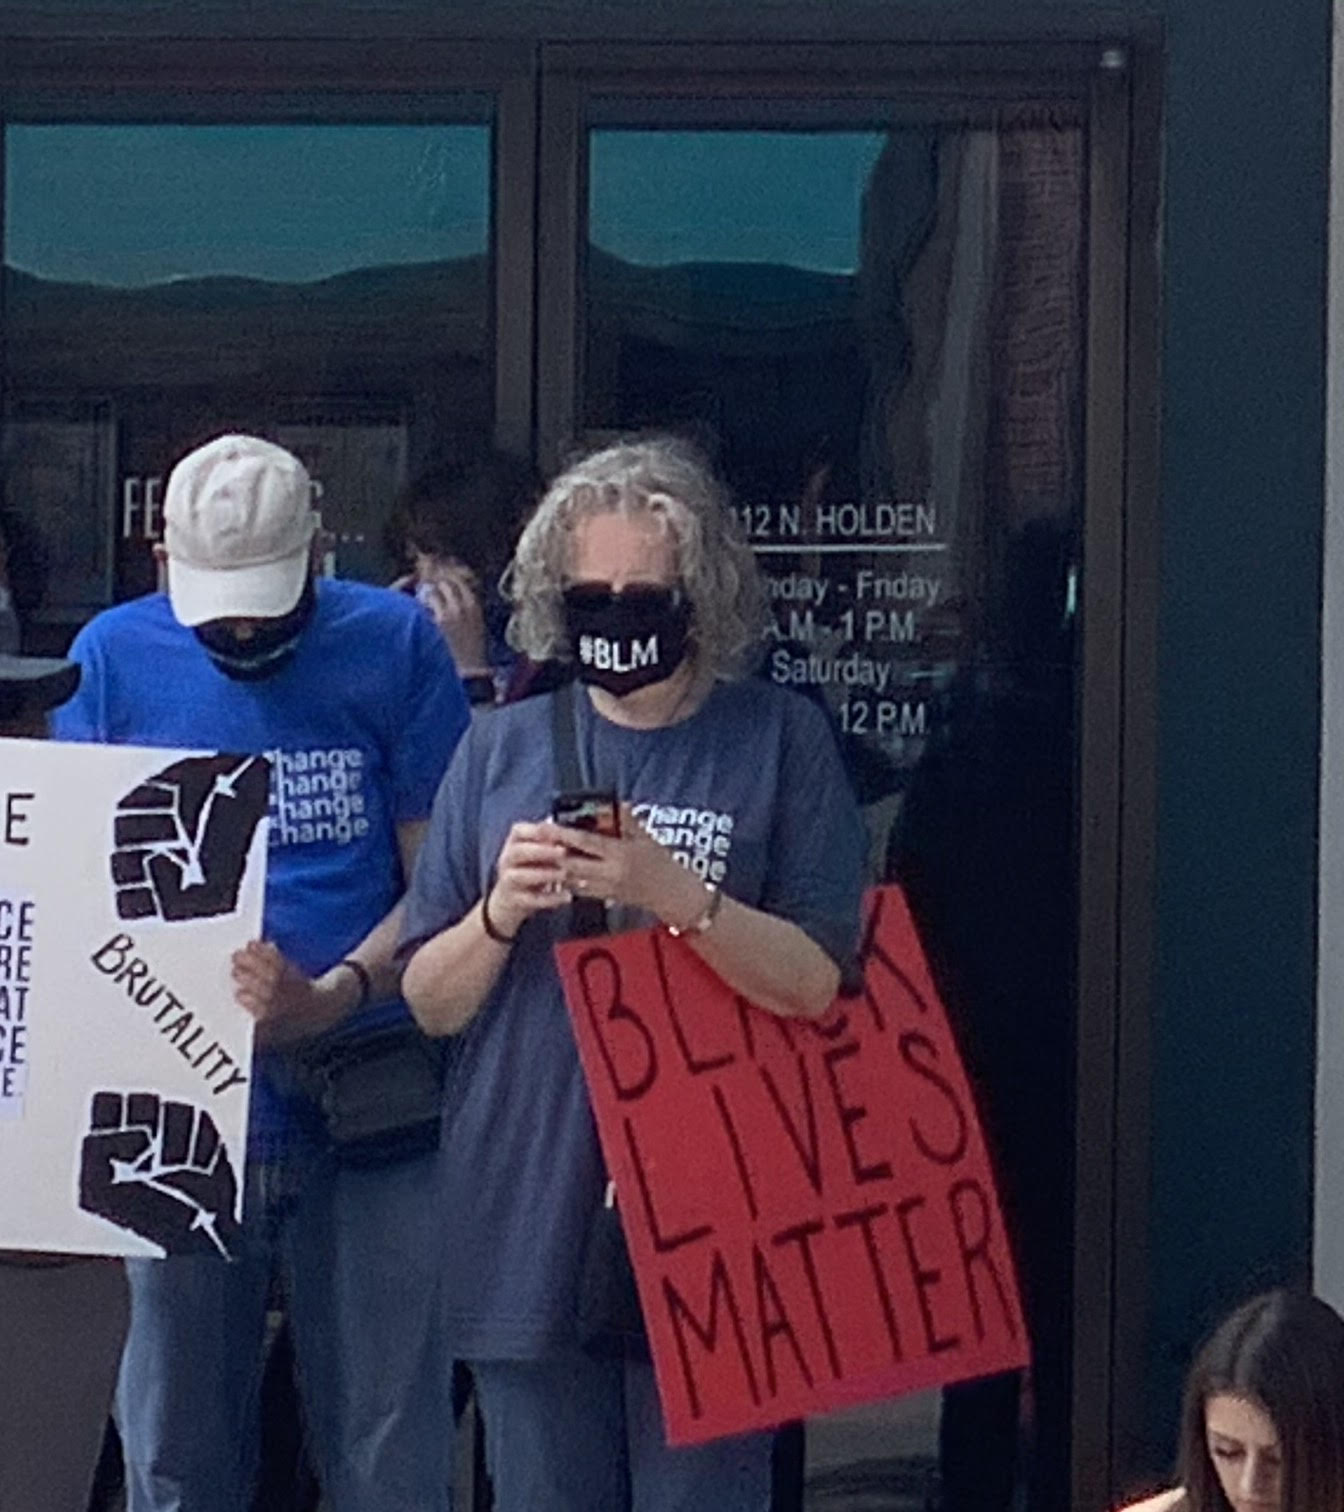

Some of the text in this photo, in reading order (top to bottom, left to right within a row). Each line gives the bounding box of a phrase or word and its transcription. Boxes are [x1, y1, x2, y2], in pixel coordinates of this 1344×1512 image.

[816, 504, 937, 535] HOLDEN
[766, 571, 829, 606] nday
[840, 610, 854, 641] 1
[579, 633, 659, 673] #BLM
[770, 650, 891, 693] Saturday
[840, 702, 869, 735] 12
[262, 748, 363, 772] hange
[271, 768, 362, 794] hange
[269, 792, 365, 820] hange
[646, 827, 731, 857] ange
[672, 851, 727, 882] nge
[577, 890, 928, 1102] BLK
[91, 932, 250, 1098] BRUTALITY
[623, 1027, 969, 1254] LIVES
[662, 1178, 1018, 1421] MATTER
